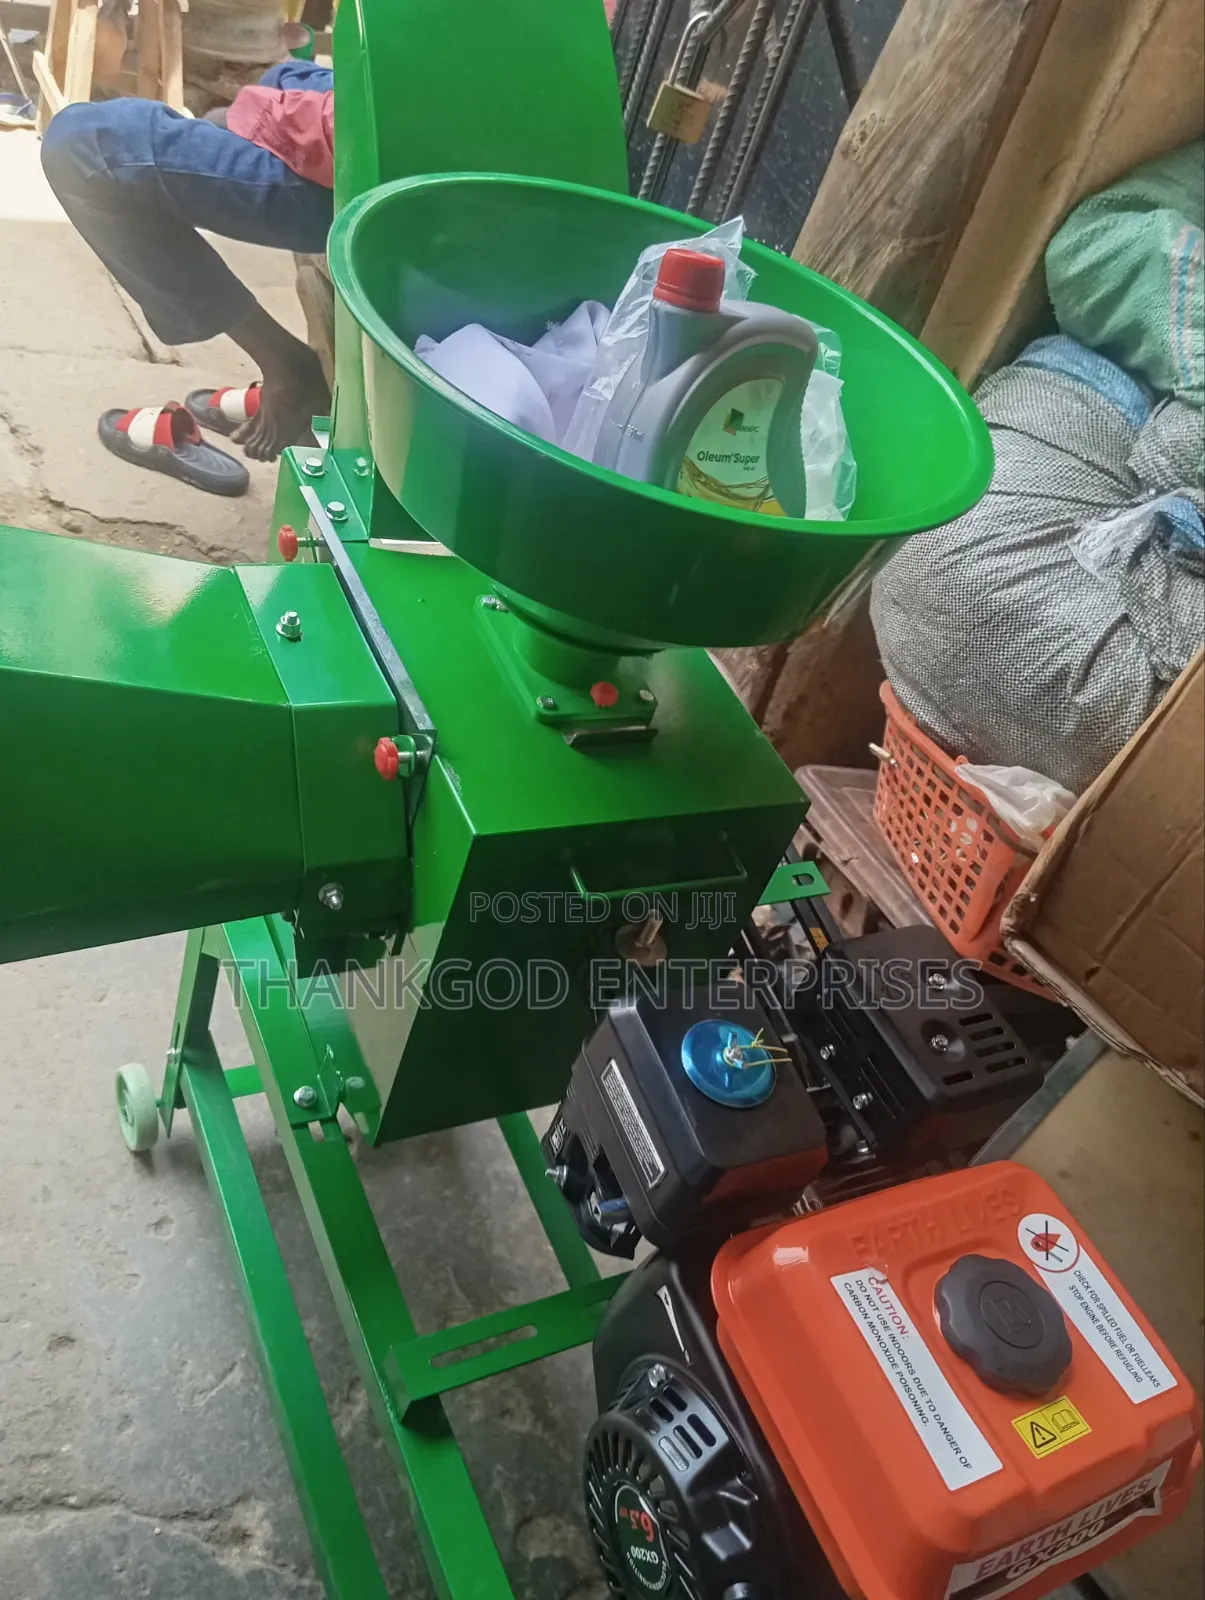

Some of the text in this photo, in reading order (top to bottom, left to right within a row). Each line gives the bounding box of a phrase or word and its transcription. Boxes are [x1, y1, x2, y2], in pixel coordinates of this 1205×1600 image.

[732, 452, 760, 465] Super
[868, 1276, 909, 1340] CAUTION:
[1068, 1284, 1144, 1384] STOP ENGINE BEFORE REFUELING
[1073, 1269, 1092, 1291] CHECK
[1087, 1288, 1101, 1304] FOR
[1113, 1326, 1128, 1344] FUEL
[1125, 1343, 1136, 1354] OR
[843, 1282, 929, 1427] CARBON MONOXIDE POISONING.
[855, 1279, 972, 1469] DO NOT USE INDOORS DUE TO DANGER OF
[630, 1545, 659, 1564] GX200
[974, 1477, 1152, 1581] EARTH LIVES
[1005, 1519, 1105, 1580] GX200
